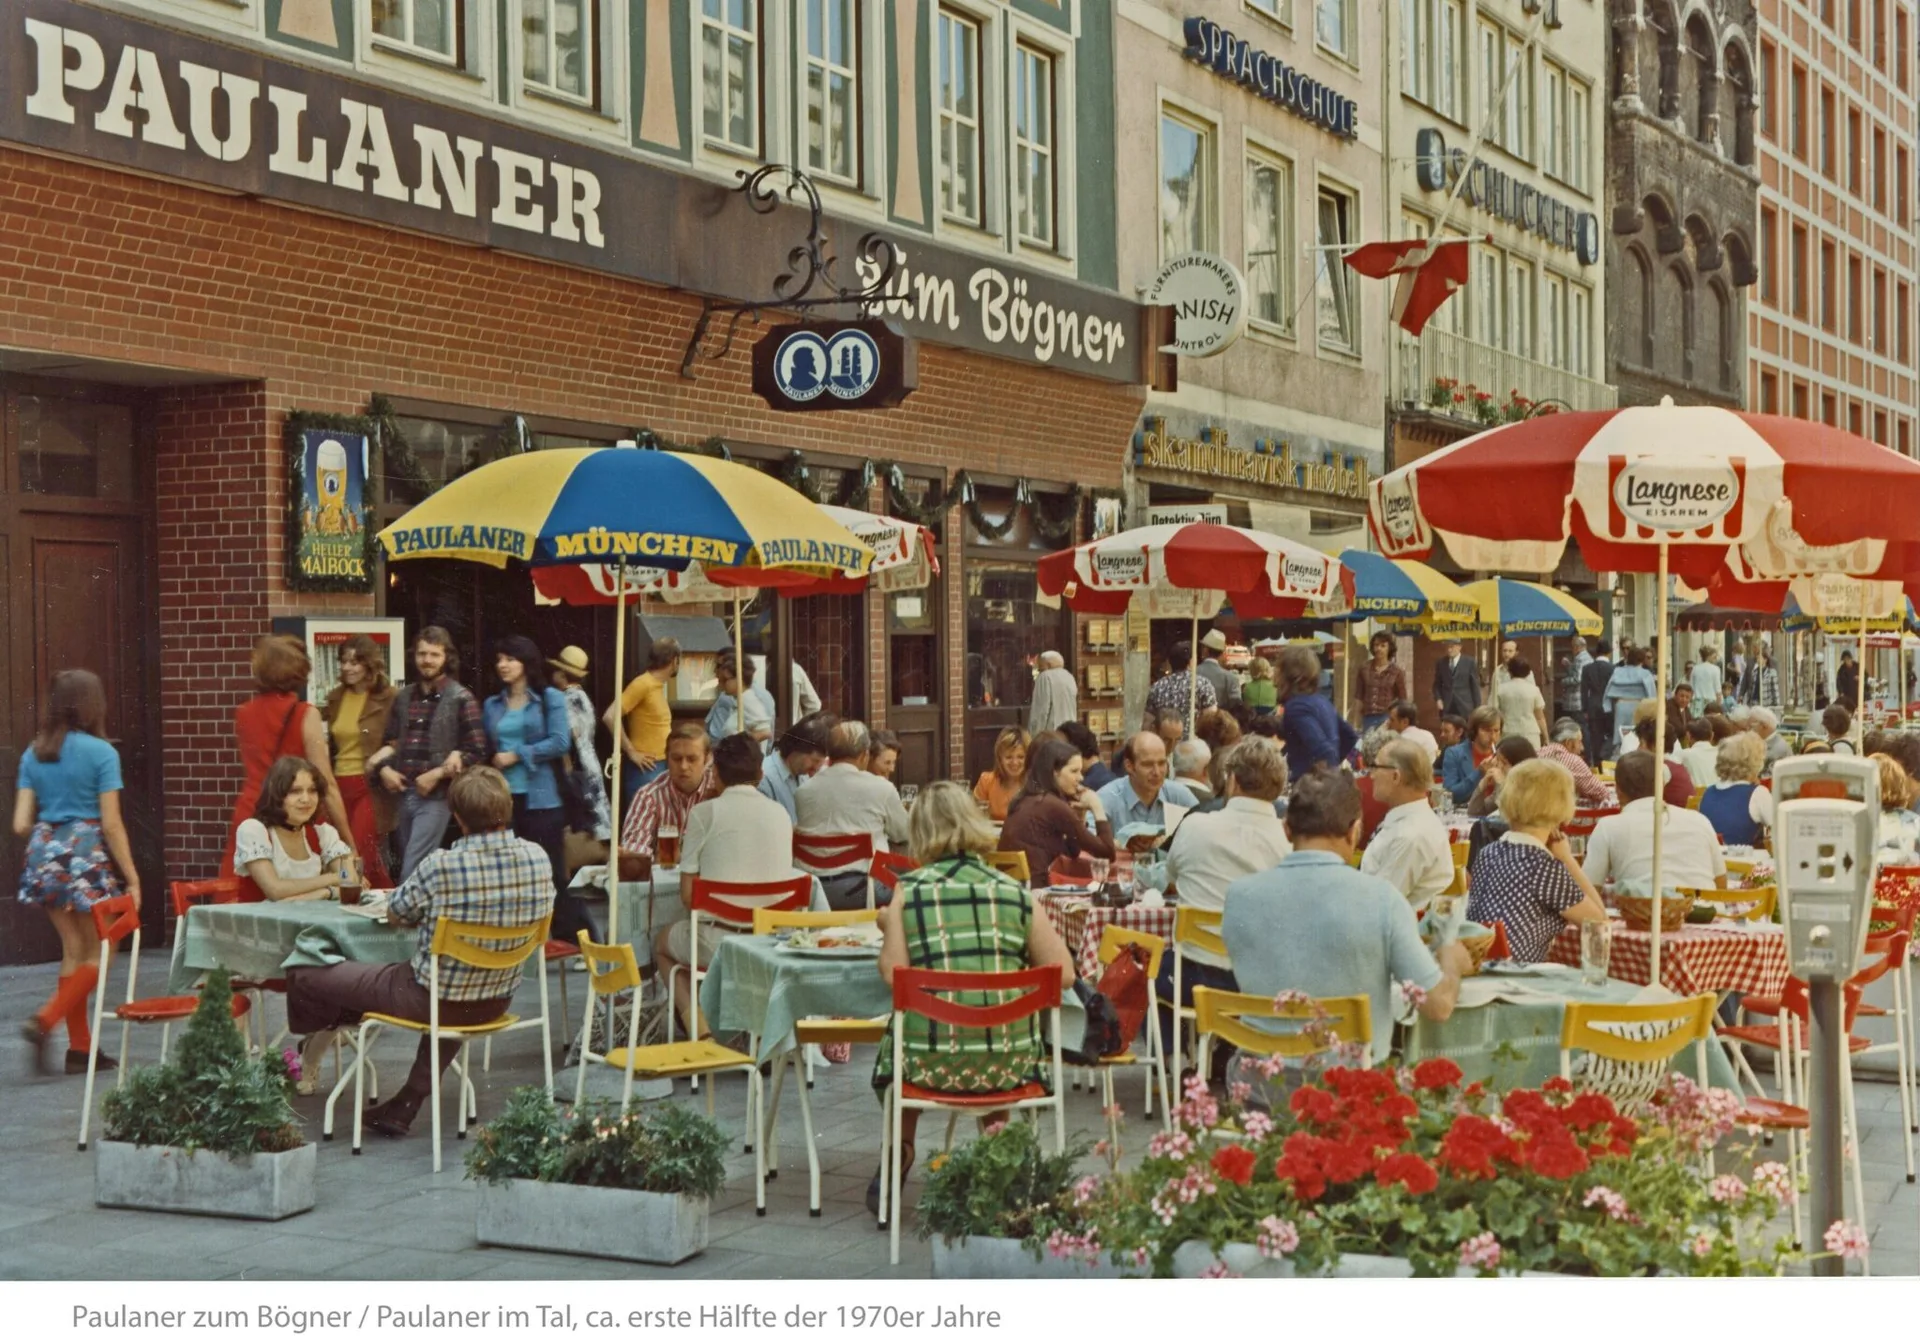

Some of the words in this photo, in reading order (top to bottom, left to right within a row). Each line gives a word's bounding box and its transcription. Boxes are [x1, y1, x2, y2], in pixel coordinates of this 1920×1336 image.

[1196, 18, 1358, 140] SPRACHSCHULE
[25, 17, 605, 248] PAULANER
[1150, 256, 1236, 301] FURNITUREMAKERS
[969, 267, 1125, 363] Bögner
[1173, 299, 1235, 325] ANISH
[1173, 332, 1222, 350] ONTROL
[784, 383, 824, 400] PAULANER
[1626, 475, 1730, 507] Langnese
[1645, 508, 1708, 517] EISKREM
[312, 542, 351, 557] HELLER
[392, 525, 527, 557] PAULANER
[555, 526, 738, 565] MÜNCHEN
[301, 556, 366, 577] MAIBOCK
[761, 538, 864, 571] PAULANER
[1096, 553, 1144, 571] Langnese
[1285, 559, 1322, 577] Langnese
[1353, 597, 1420, 613] NCHEN
